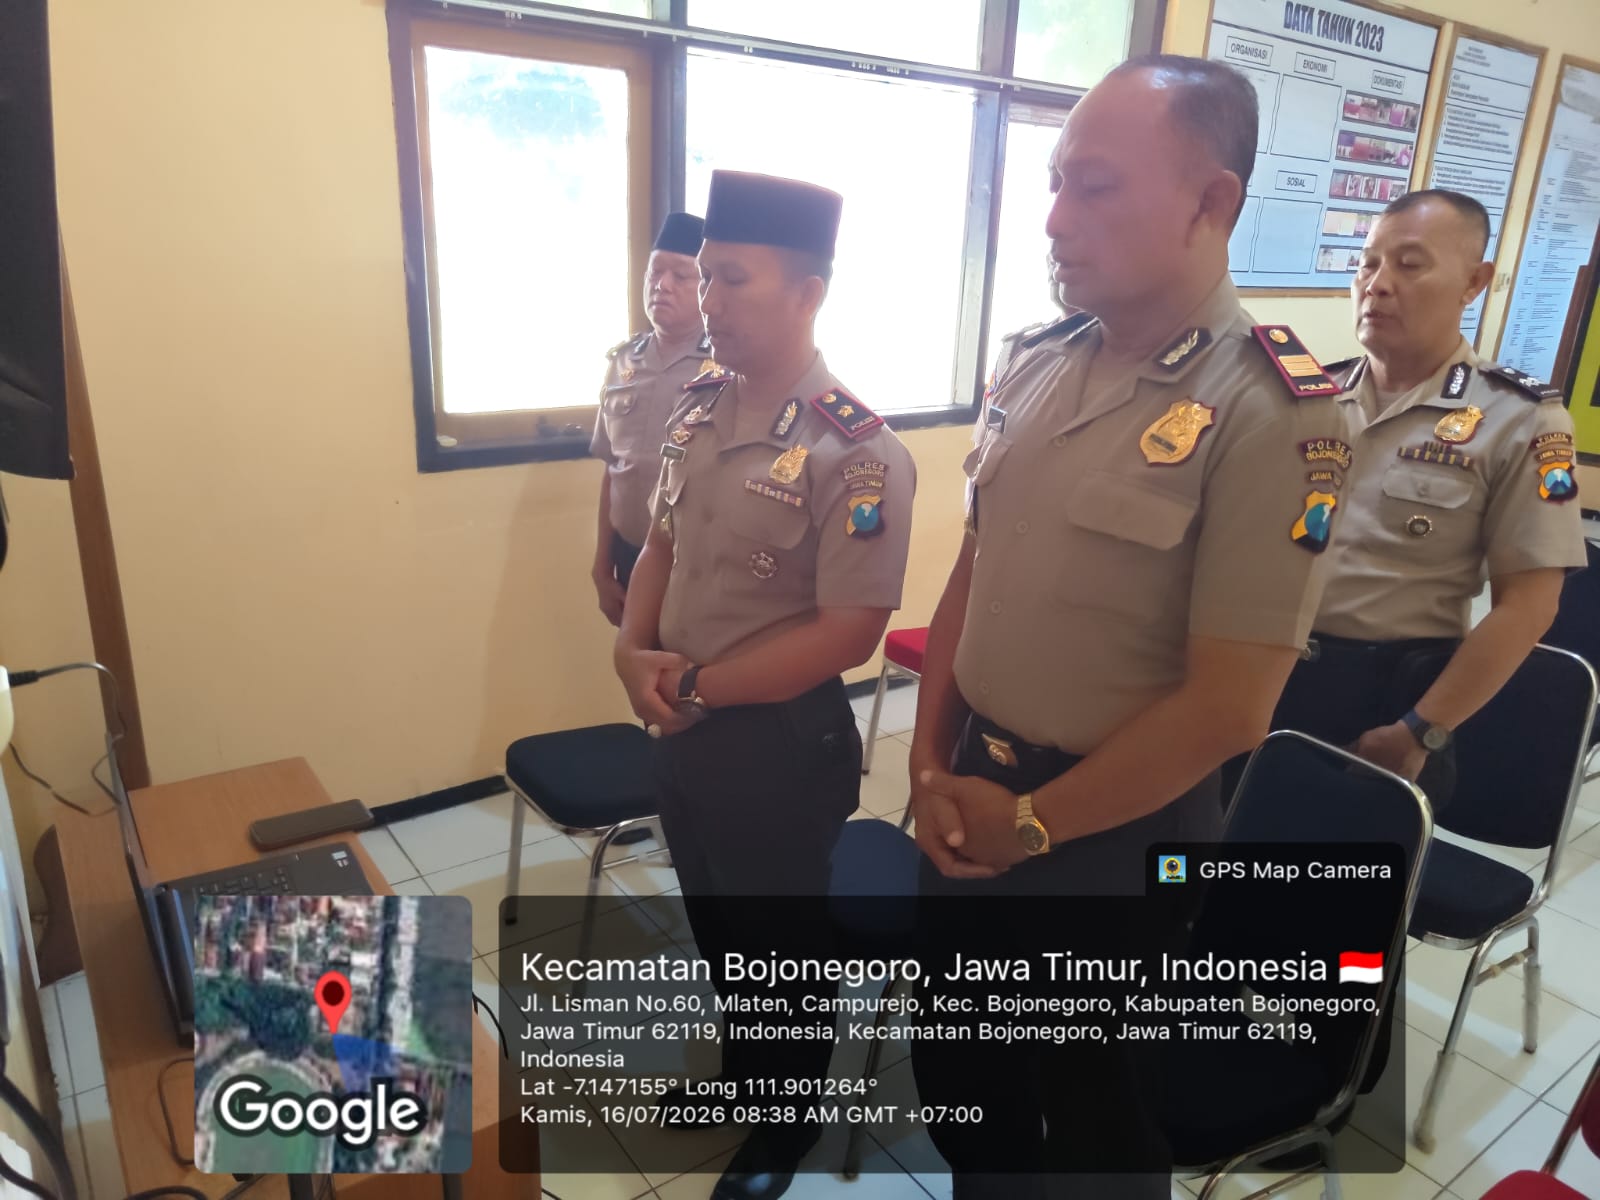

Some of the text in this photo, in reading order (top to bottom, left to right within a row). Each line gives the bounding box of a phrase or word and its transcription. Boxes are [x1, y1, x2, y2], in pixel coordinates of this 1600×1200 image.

[1283, 1, 1385, 53] DATA TAHUN 2023
[1229, 42, 1269, 60] ORGANISASI
[1302, 59, 1329, 73] EKONOMI
[1286, 177, 1306, 187] SOSIAL
[1298, 382, 1334, 392] POLISI
[1306, 440, 1352, 460] POLRES
[843, 461, 885, 474] POLRES
[1310, 471, 1332, 481] JAWA
